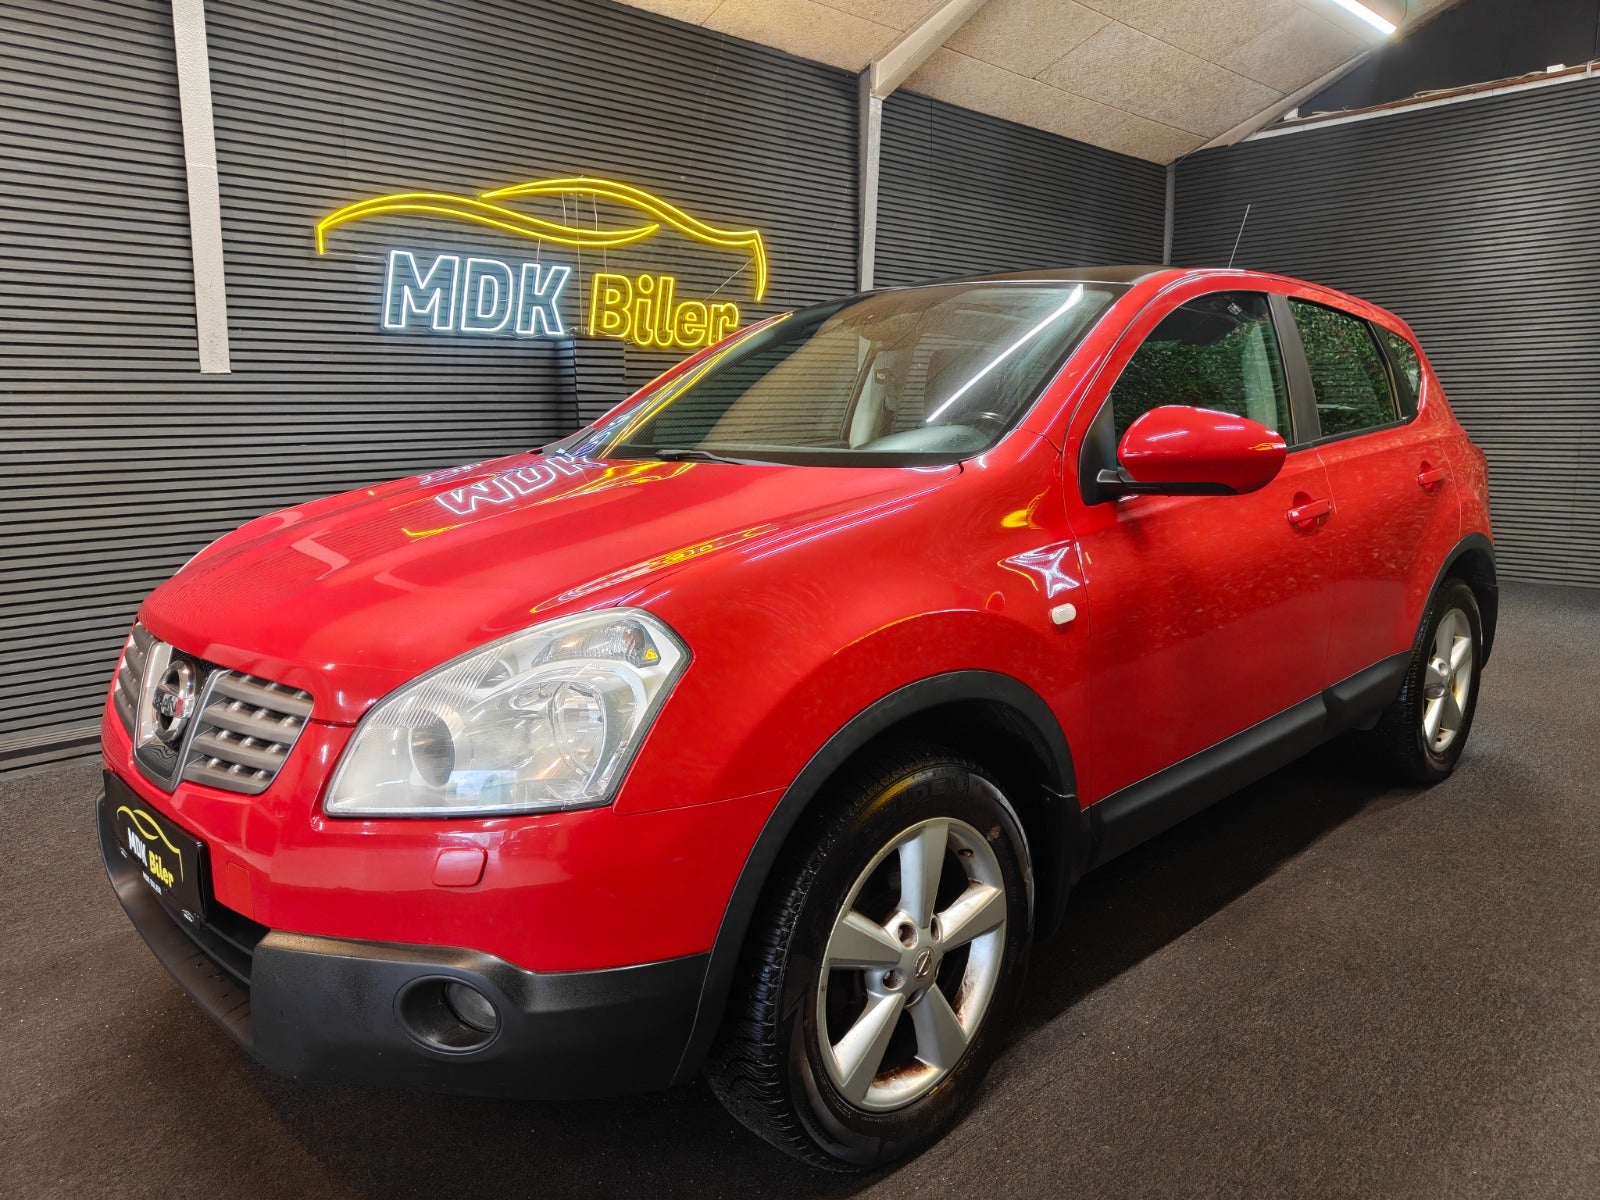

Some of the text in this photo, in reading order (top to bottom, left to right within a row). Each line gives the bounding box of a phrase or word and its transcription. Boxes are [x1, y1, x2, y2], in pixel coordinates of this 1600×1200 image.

[383, 249, 740, 347] MDK Biler
[127, 826, 148, 867] MDK
[148, 849, 174, 888] Biler
